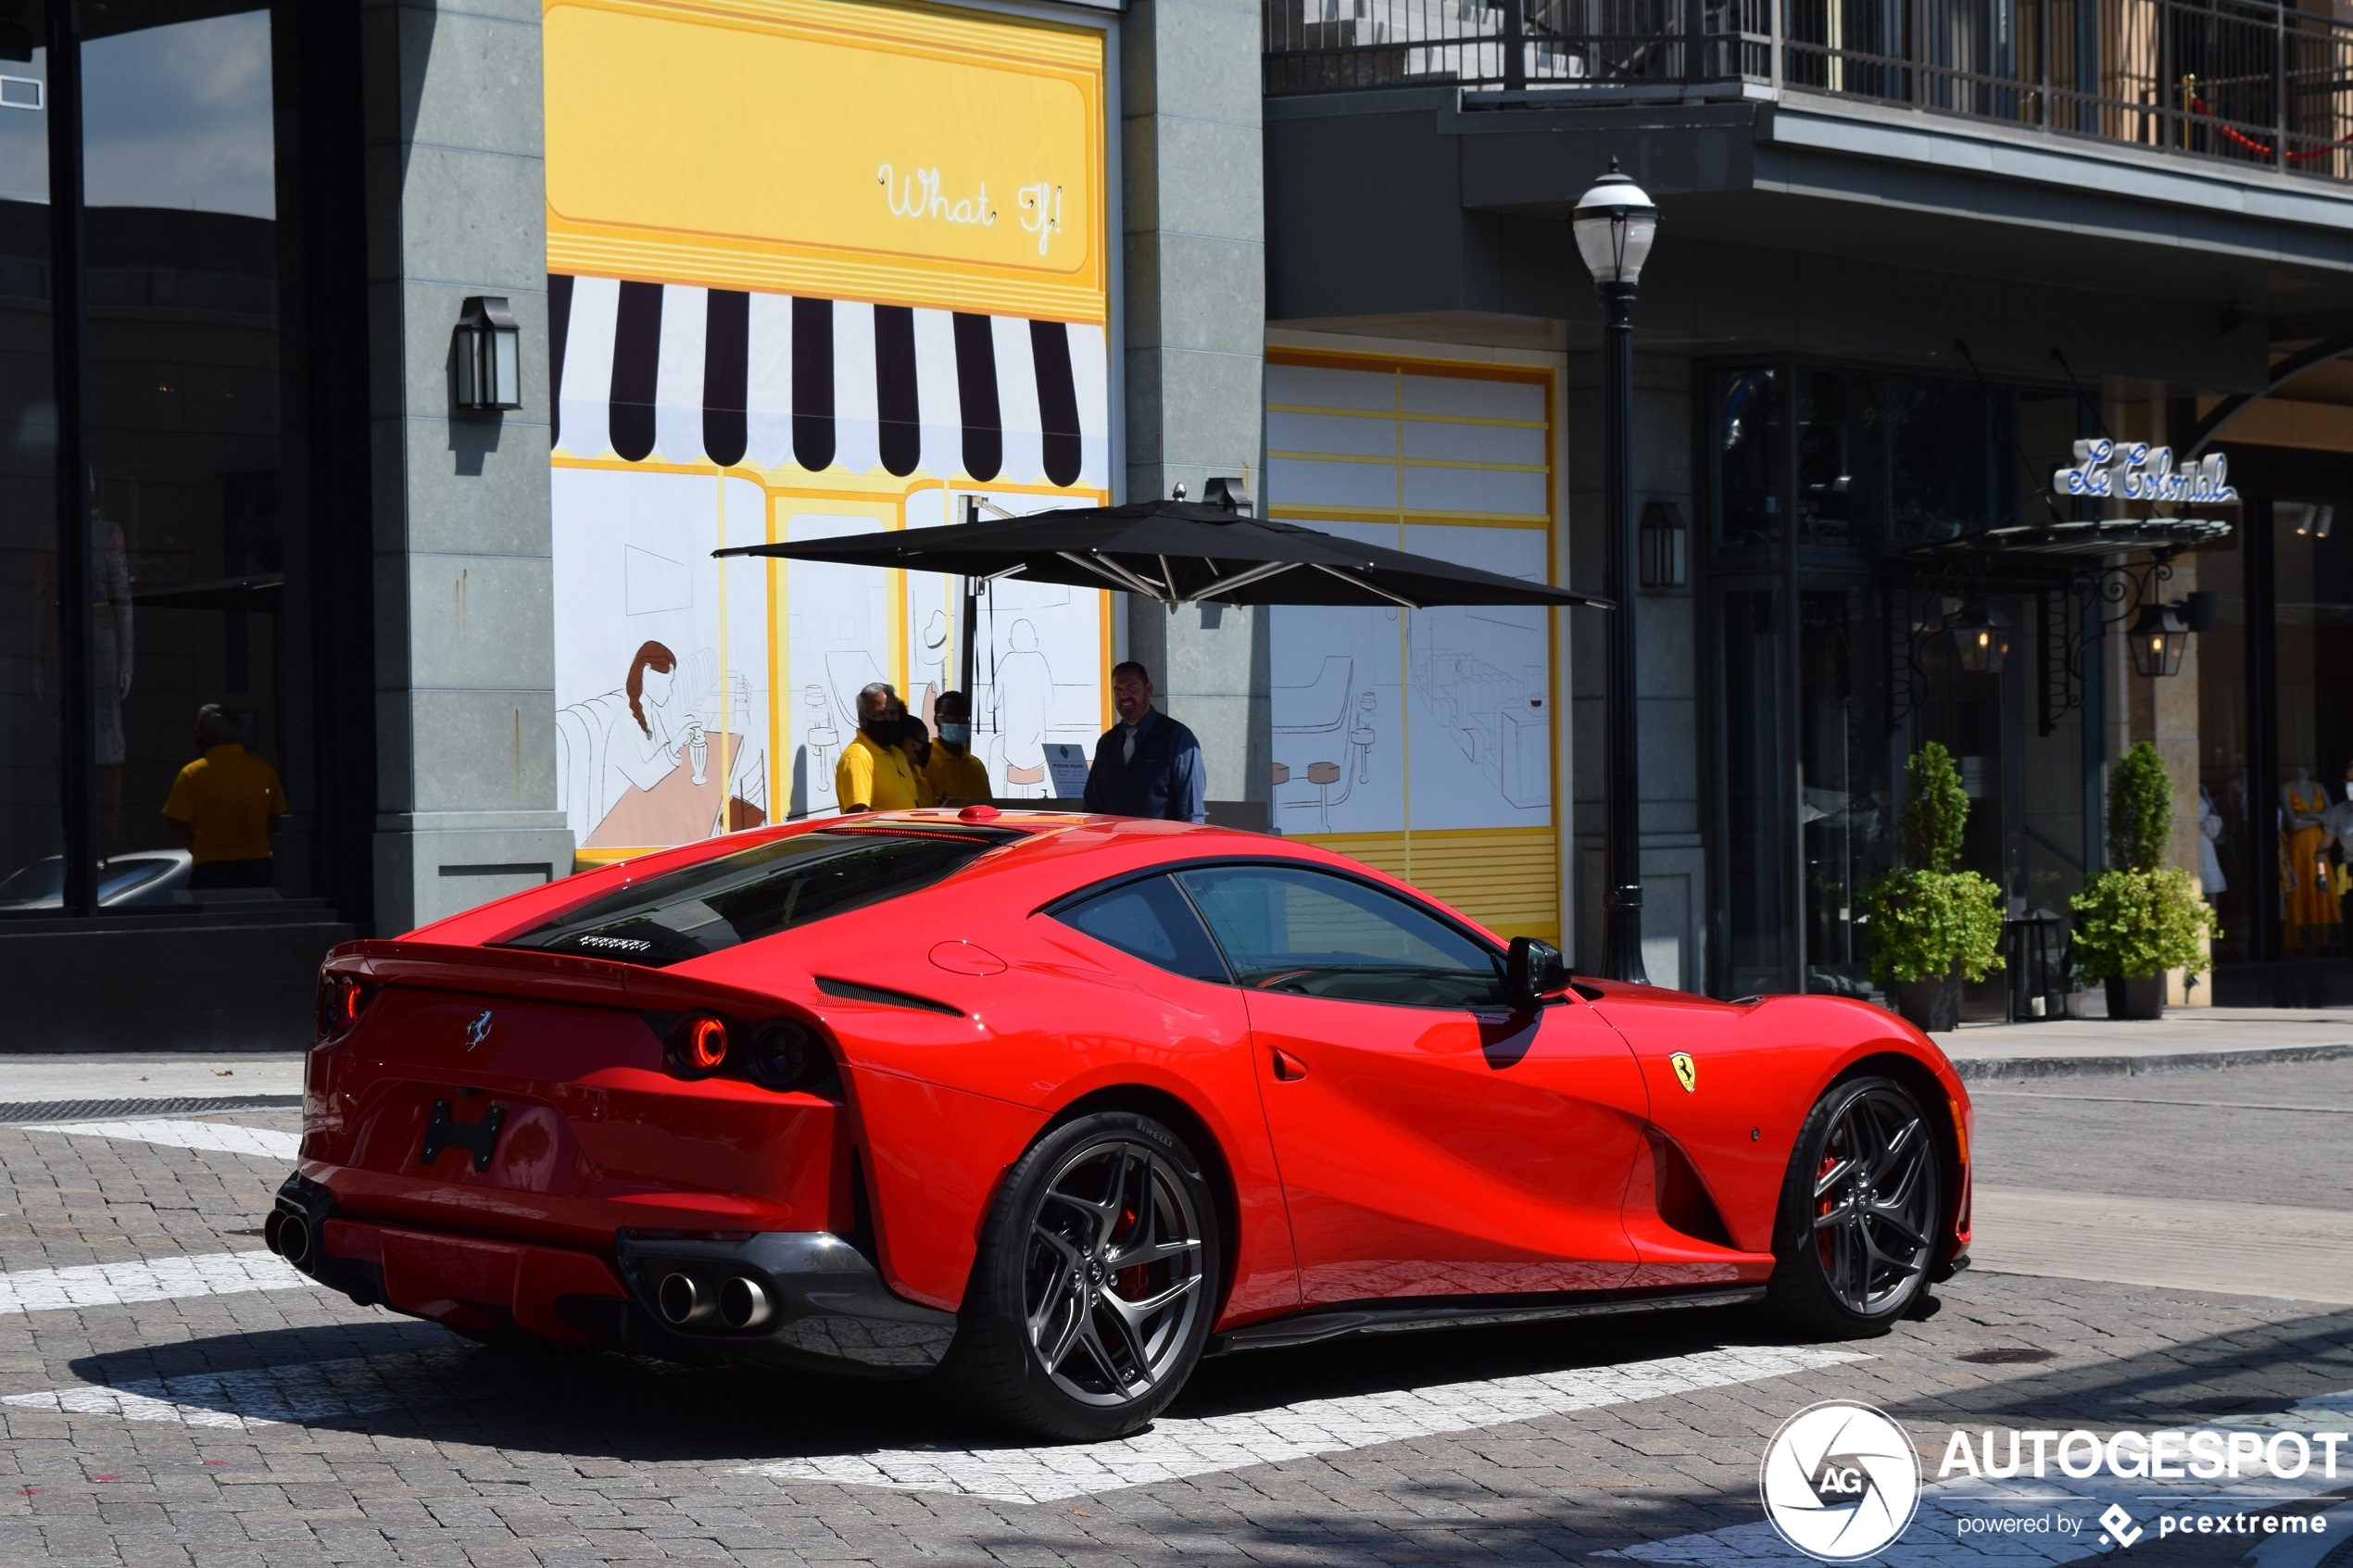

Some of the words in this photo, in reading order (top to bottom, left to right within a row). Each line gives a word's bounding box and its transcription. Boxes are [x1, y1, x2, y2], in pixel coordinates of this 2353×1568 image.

[878, 163, 997, 226] What
[2056, 438, 2114, 497] Le
[2116, 442, 2238, 502] Colonial
[1136, 1118, 1174, 1148] PIRELLI
